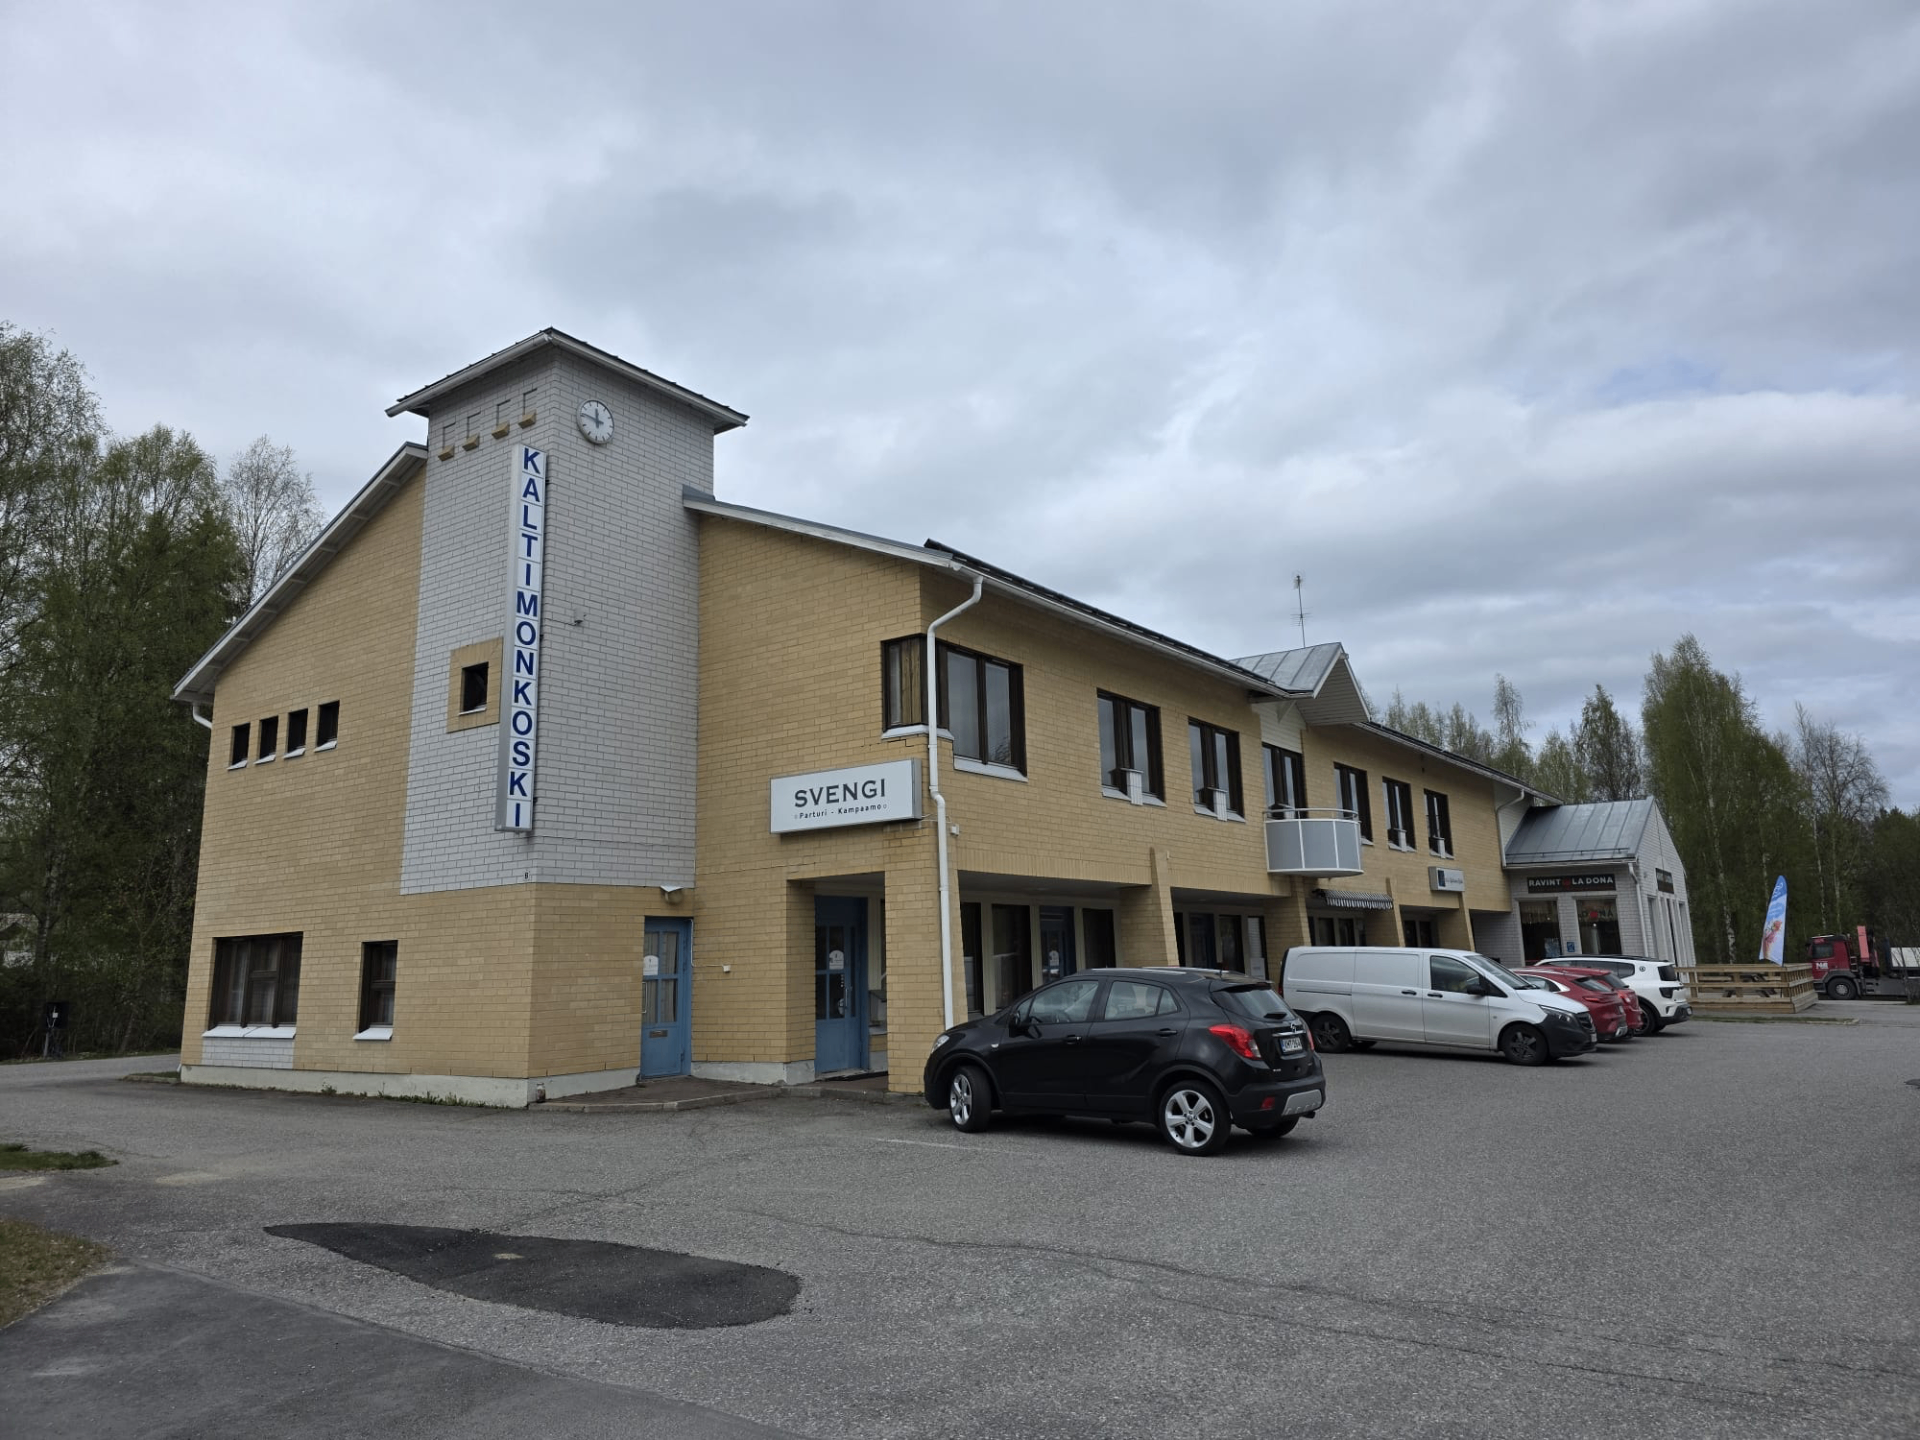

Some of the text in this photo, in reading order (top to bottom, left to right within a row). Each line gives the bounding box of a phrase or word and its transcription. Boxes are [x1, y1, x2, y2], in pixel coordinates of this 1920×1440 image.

[509, 447, 541, 827] KALTIMONKOSKI
[794, 778, 885, 808] SVENGI
[799, 808, 827, 819] Parturi
[838, 803, 881, 814] Kampaamo
[1585, 876, 1614, 885] DONA
